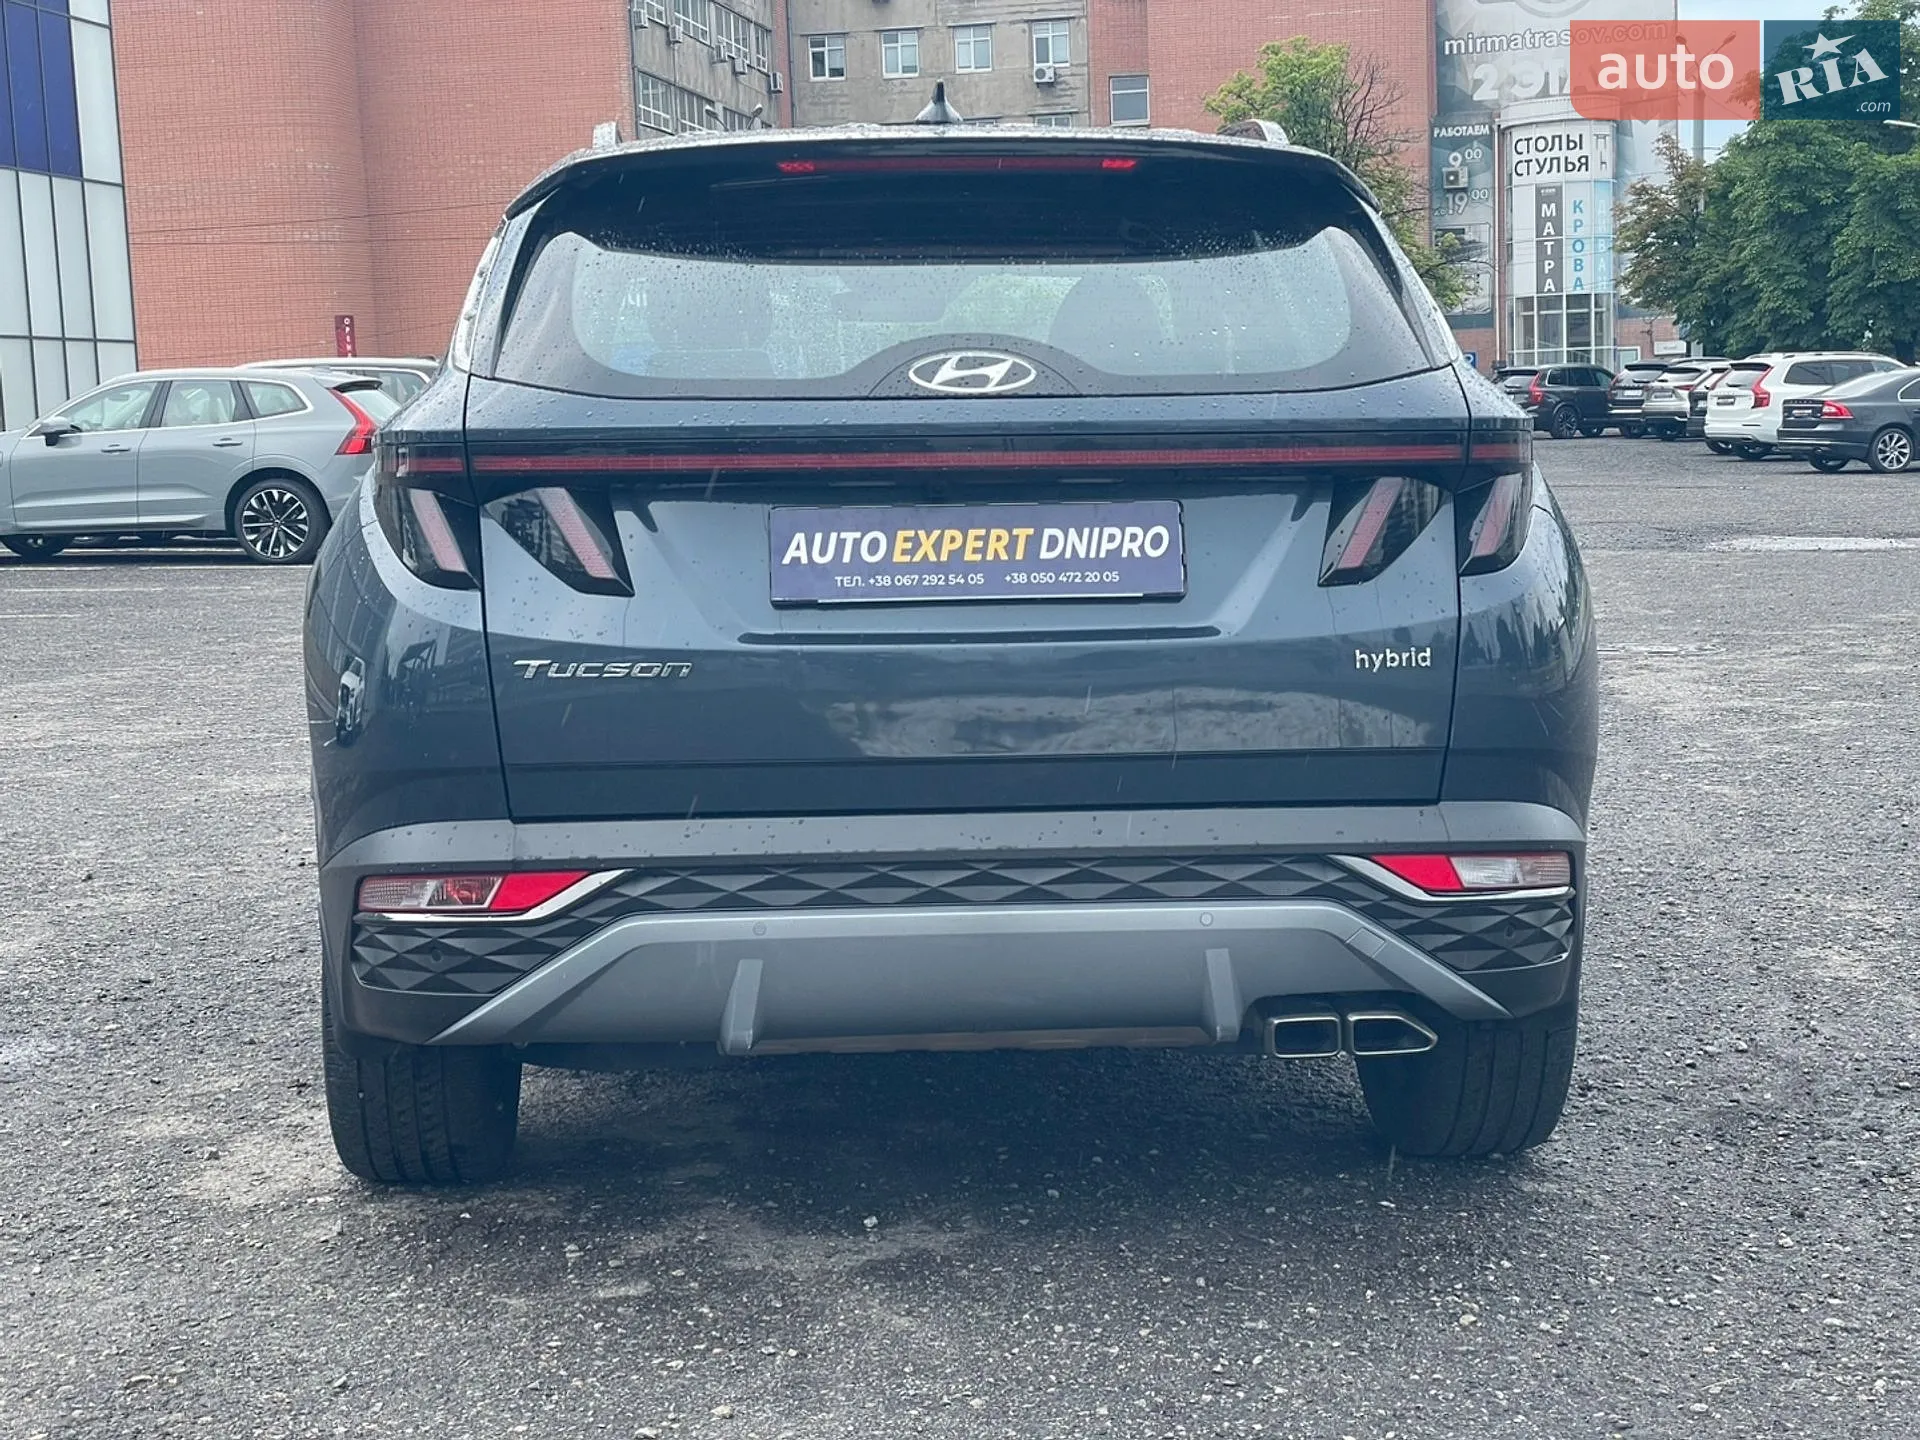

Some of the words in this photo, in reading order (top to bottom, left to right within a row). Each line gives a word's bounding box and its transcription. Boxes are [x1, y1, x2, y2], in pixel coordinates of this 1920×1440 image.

[1444, 21, 1669, 56] mirmatrasov.com
[1472, 63, 1499, 101] 2
[1433, 124, 1490, 137] РАБОТАЕМ
[1514, 133, 1583, 155] СТОЛЫ
[1514, 155, 1589, 176] СТУЛЬЯ
[781, 531, 887, 564] AUTO
[892, 528, 1034, 562] EXPERT
[1039, 525, 1169, 559] DNIPRO
[834, 576, 865, 587] ТЕЛ.
[868, 575, 892, 586] +38
[895, 575, 919, 586] 067
[922, 574, 945, 585] 292
[948, 574, 965, 585] 54
[967, 573, 985, 584] 05
[1004, 572, 1028, 584] +38
[1030, 572, 1056, 583] 050
[1058, 572, 1082, 582] 472
[1081, 571, 1100, 582] 20
[1102, 571, 1120, 582] 05
[1355, 647, 1432, 673] hybrid
